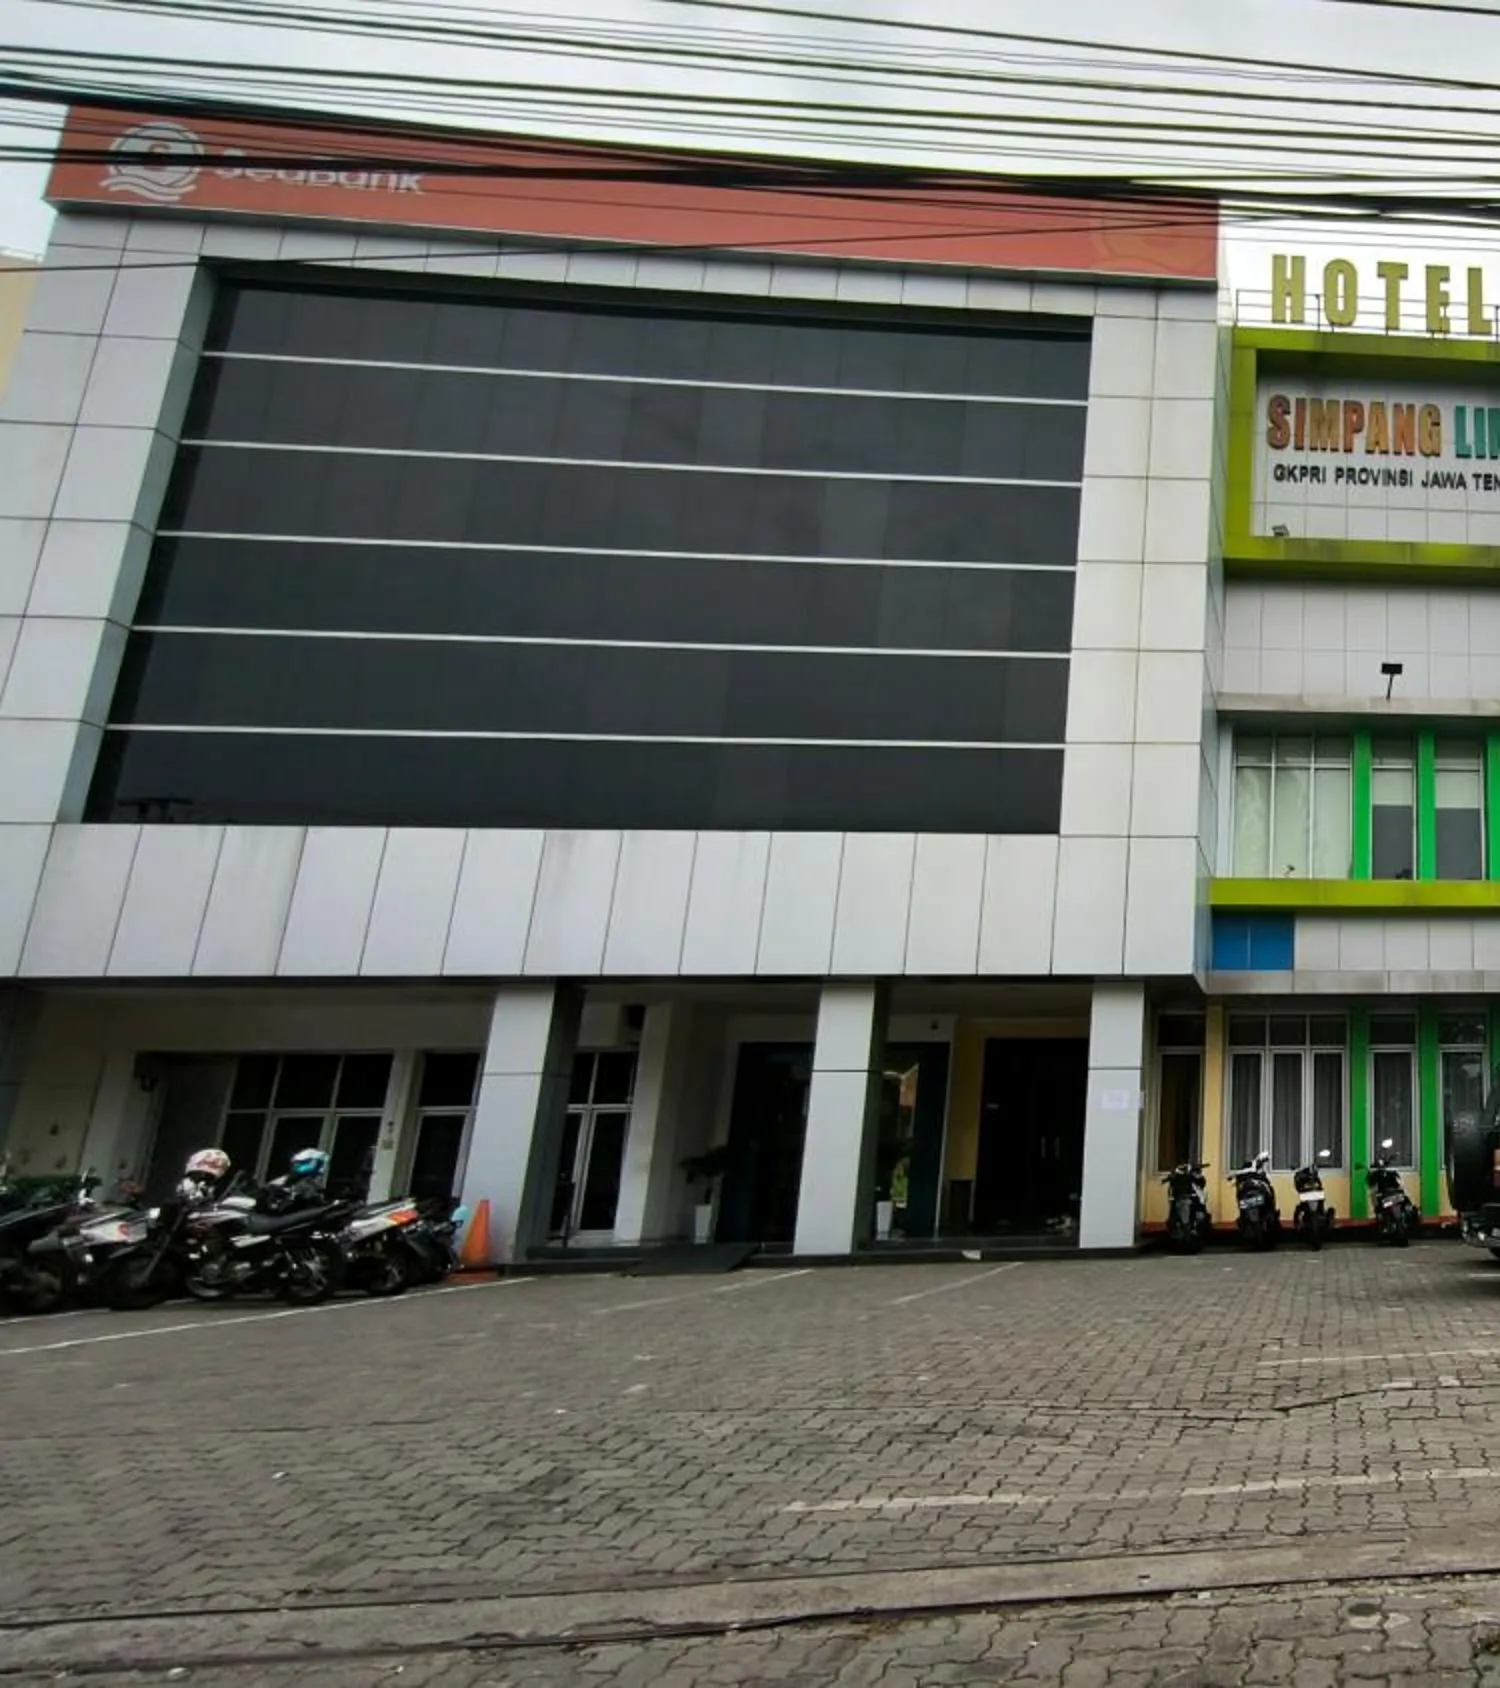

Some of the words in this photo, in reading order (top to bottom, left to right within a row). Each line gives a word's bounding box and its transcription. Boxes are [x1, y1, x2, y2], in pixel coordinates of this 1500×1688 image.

[1271, 254, 1493, 335] HOTEL
[1266, 394, 1442, 457] SIMPANG
[1273, 463, 1327, 484] GKPRI
[1334, 466, 1414, 487] PROVINSI
[1421, 470, 1467, 491] JAWA
